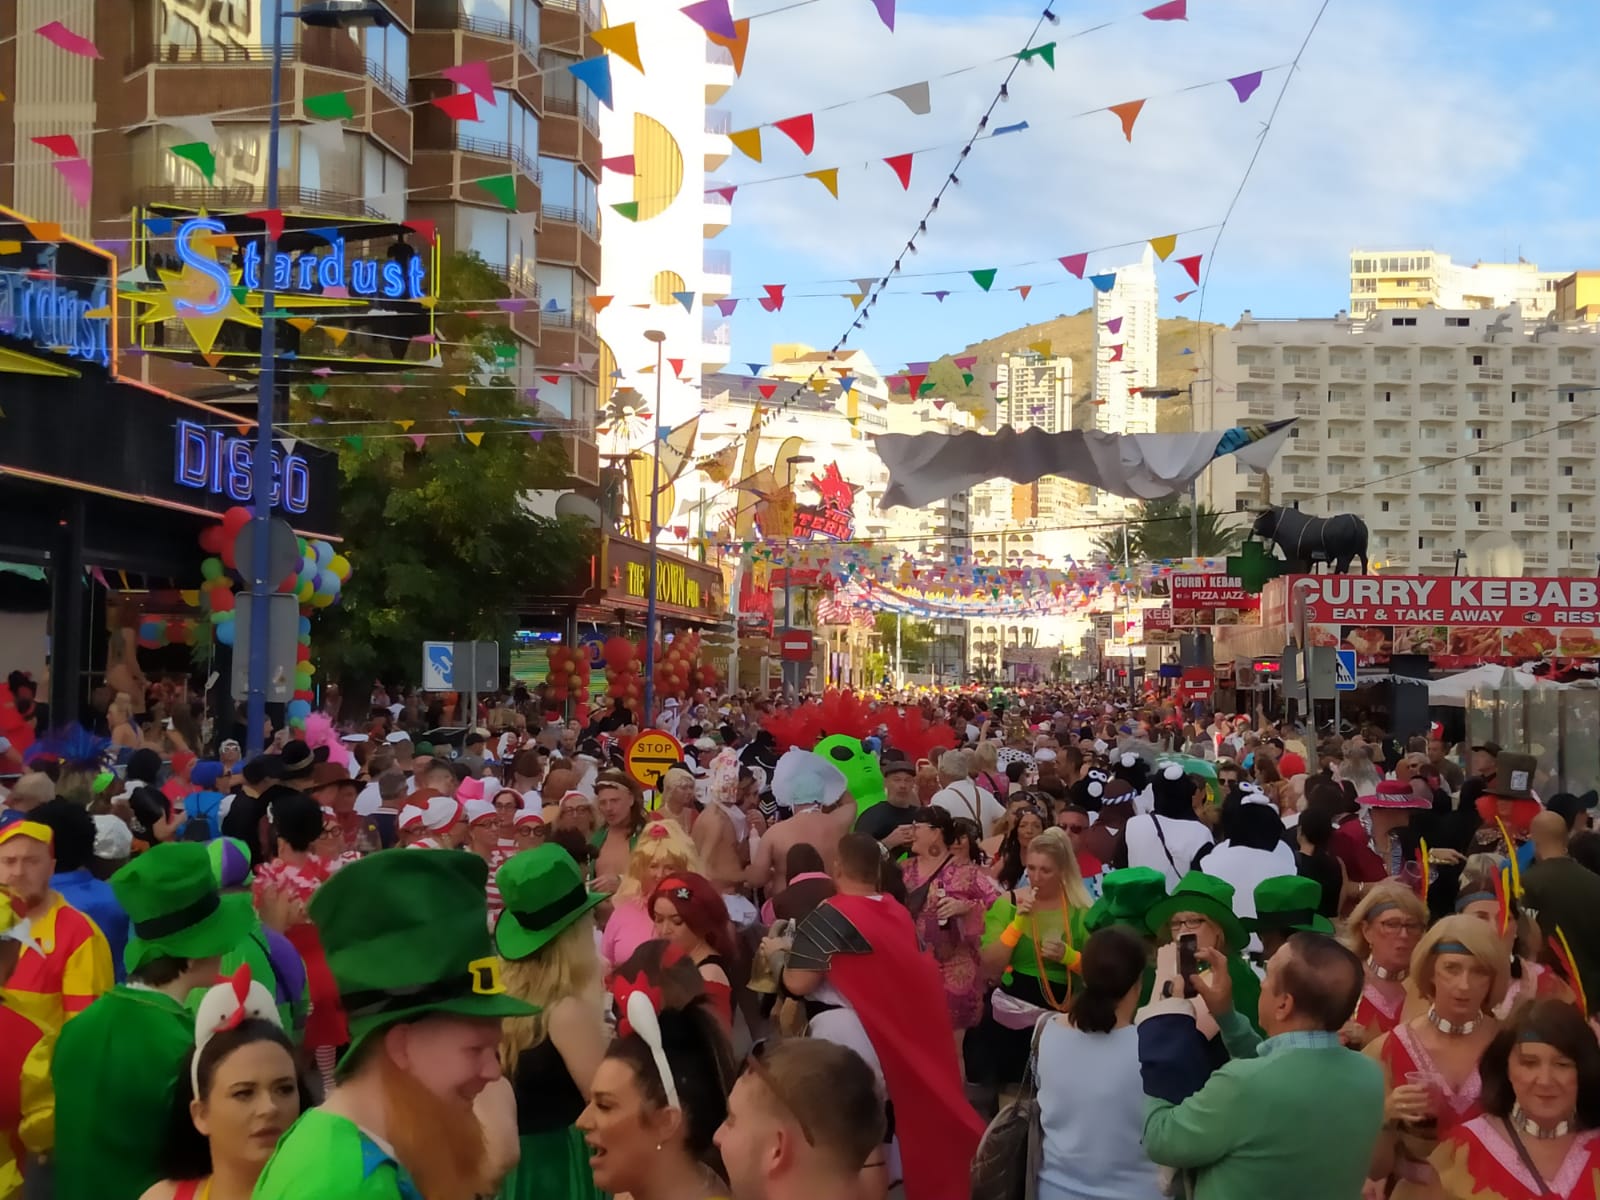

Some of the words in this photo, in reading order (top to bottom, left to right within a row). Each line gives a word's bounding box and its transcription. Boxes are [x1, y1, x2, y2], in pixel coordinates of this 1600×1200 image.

[175, 218, 426, 315] Stardust
[627, 561, 645, 597] THE
[647, 559, 685, 606] ROWN
[1292, 577, 1437, 606] CURRY
[1450, 579, 1599, 608] KEBAB
[1191, 591, 1219, 600] PIZZA
[1220, 591, 1244, 600] JAZZ
[1332, 608, 1368, 620] EAT
[1374, 608, 1388, 621] &
[1394, 609, 1444, 621] TAKE
[1450, 609, 1504, 622] AWAY
[638, 743, 672, 753] STOP
